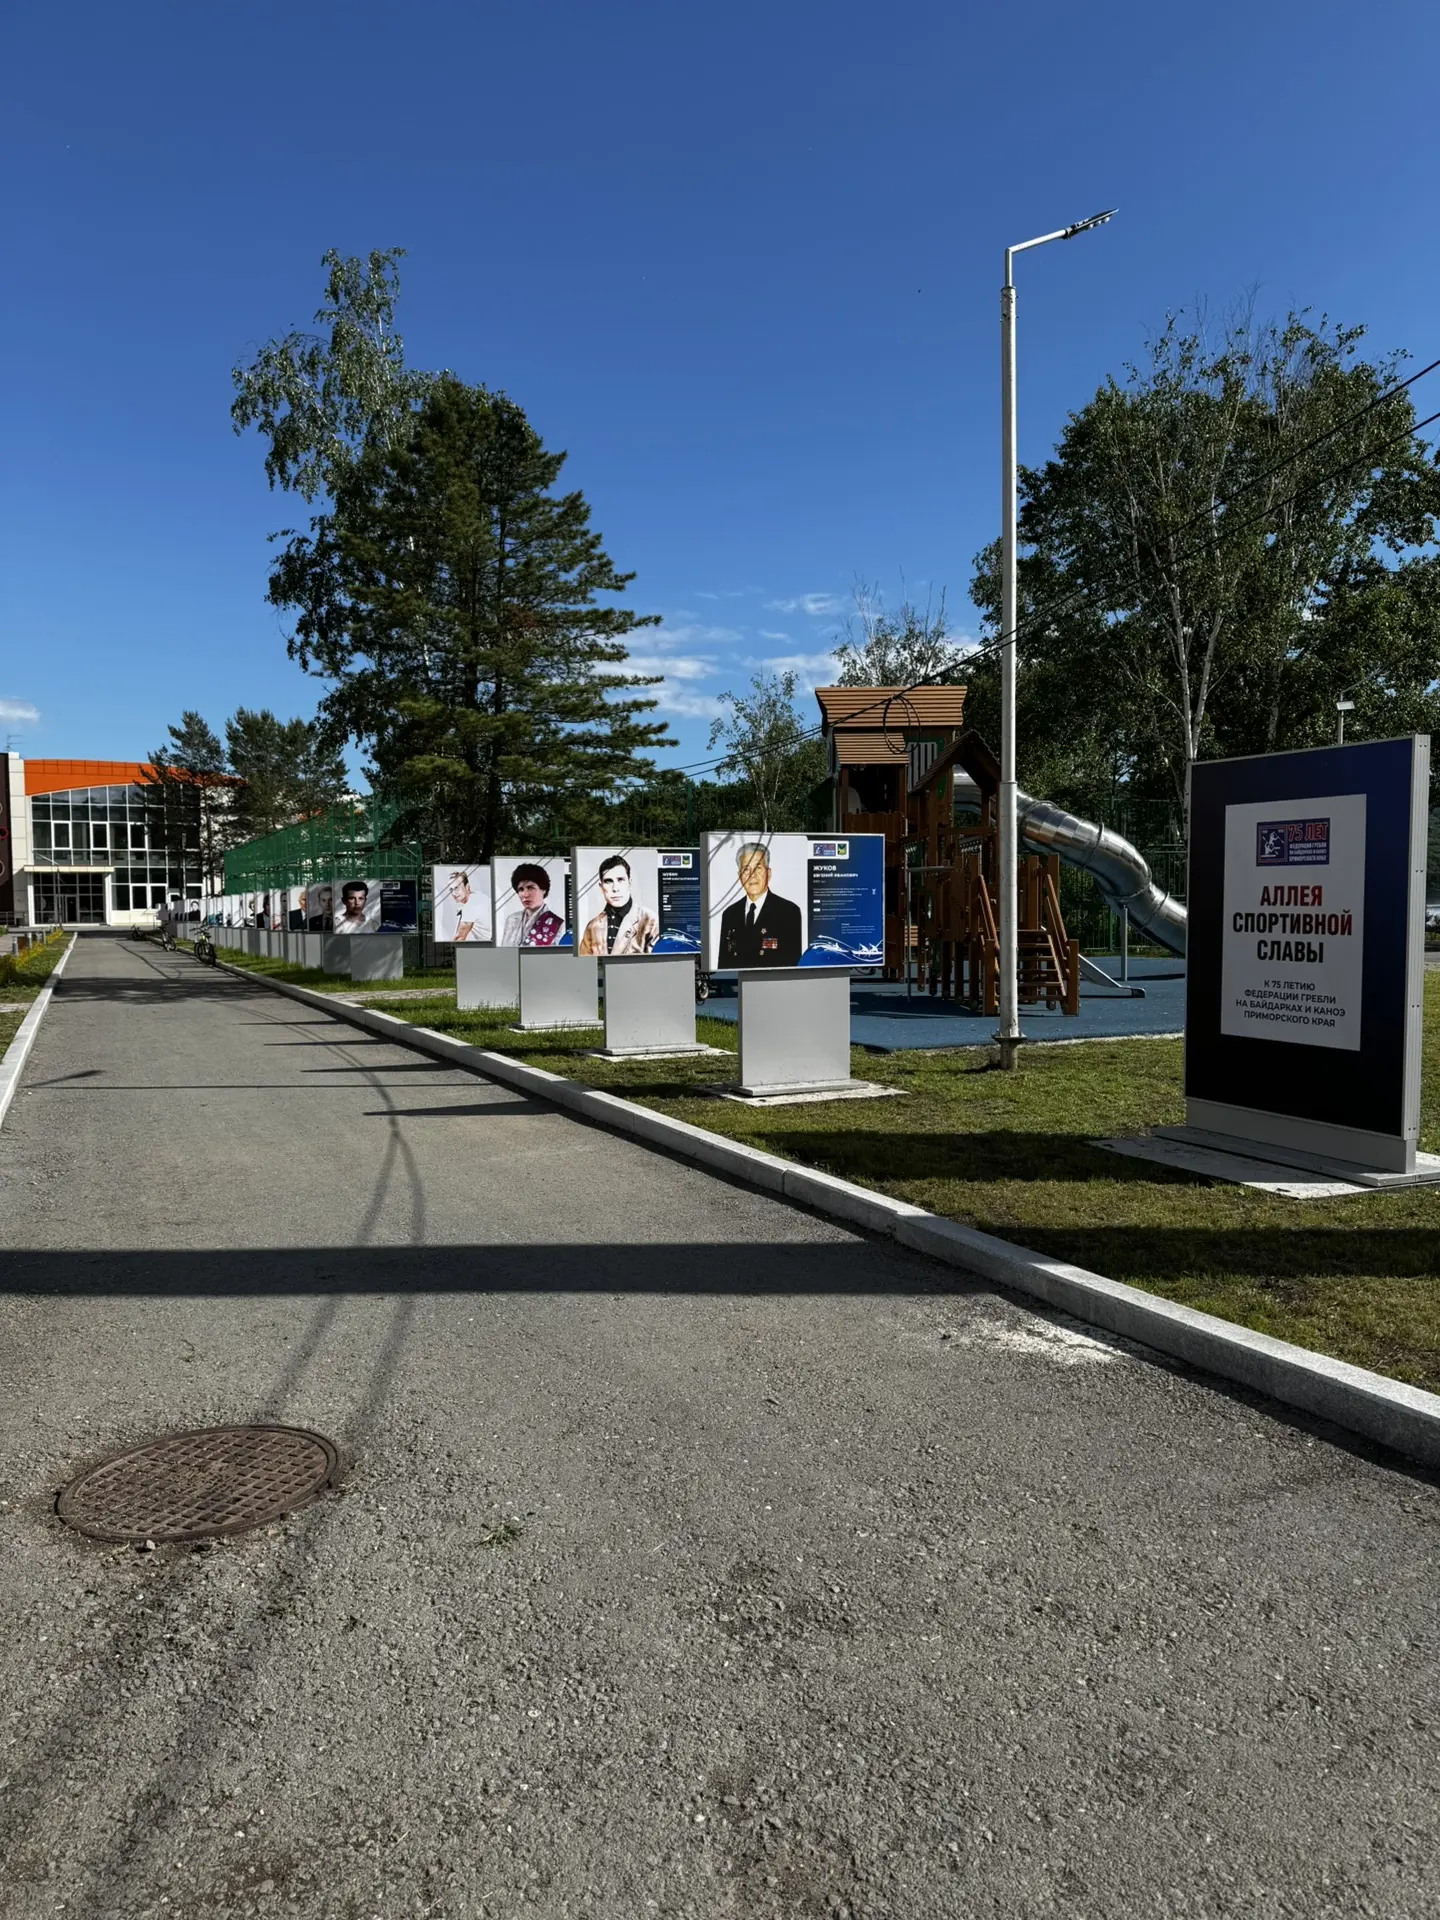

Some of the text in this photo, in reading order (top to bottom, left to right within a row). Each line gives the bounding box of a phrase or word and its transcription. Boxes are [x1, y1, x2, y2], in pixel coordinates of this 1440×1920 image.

[1288, 823, 1328, 841] 75 ЛЕТ
[1260, 885, 1322, 906] АЛЛЕЯ
[1232, 909, 1352, 936] СПОРТИВНОЙ
[1256, 940, 1324, 963] СЛАВЫ
[1272, 980, 1281, 988] 75
[1283, 981, 1315, 991] ЛЕТИЮ
[1244, 989, 1336, 1004] ФЕДЕРАЦИИ ГРЕБЛИ
[1236, 999, 1248, 1007] НА
[1250, 1000, 1302, 1012] БАЙДАРКАХ
[1314, 1007, 1346, 1017] КАНОЭ
[1244, 1010, 1336, 1027] ПРИМОРСКОГО КРАЯ
